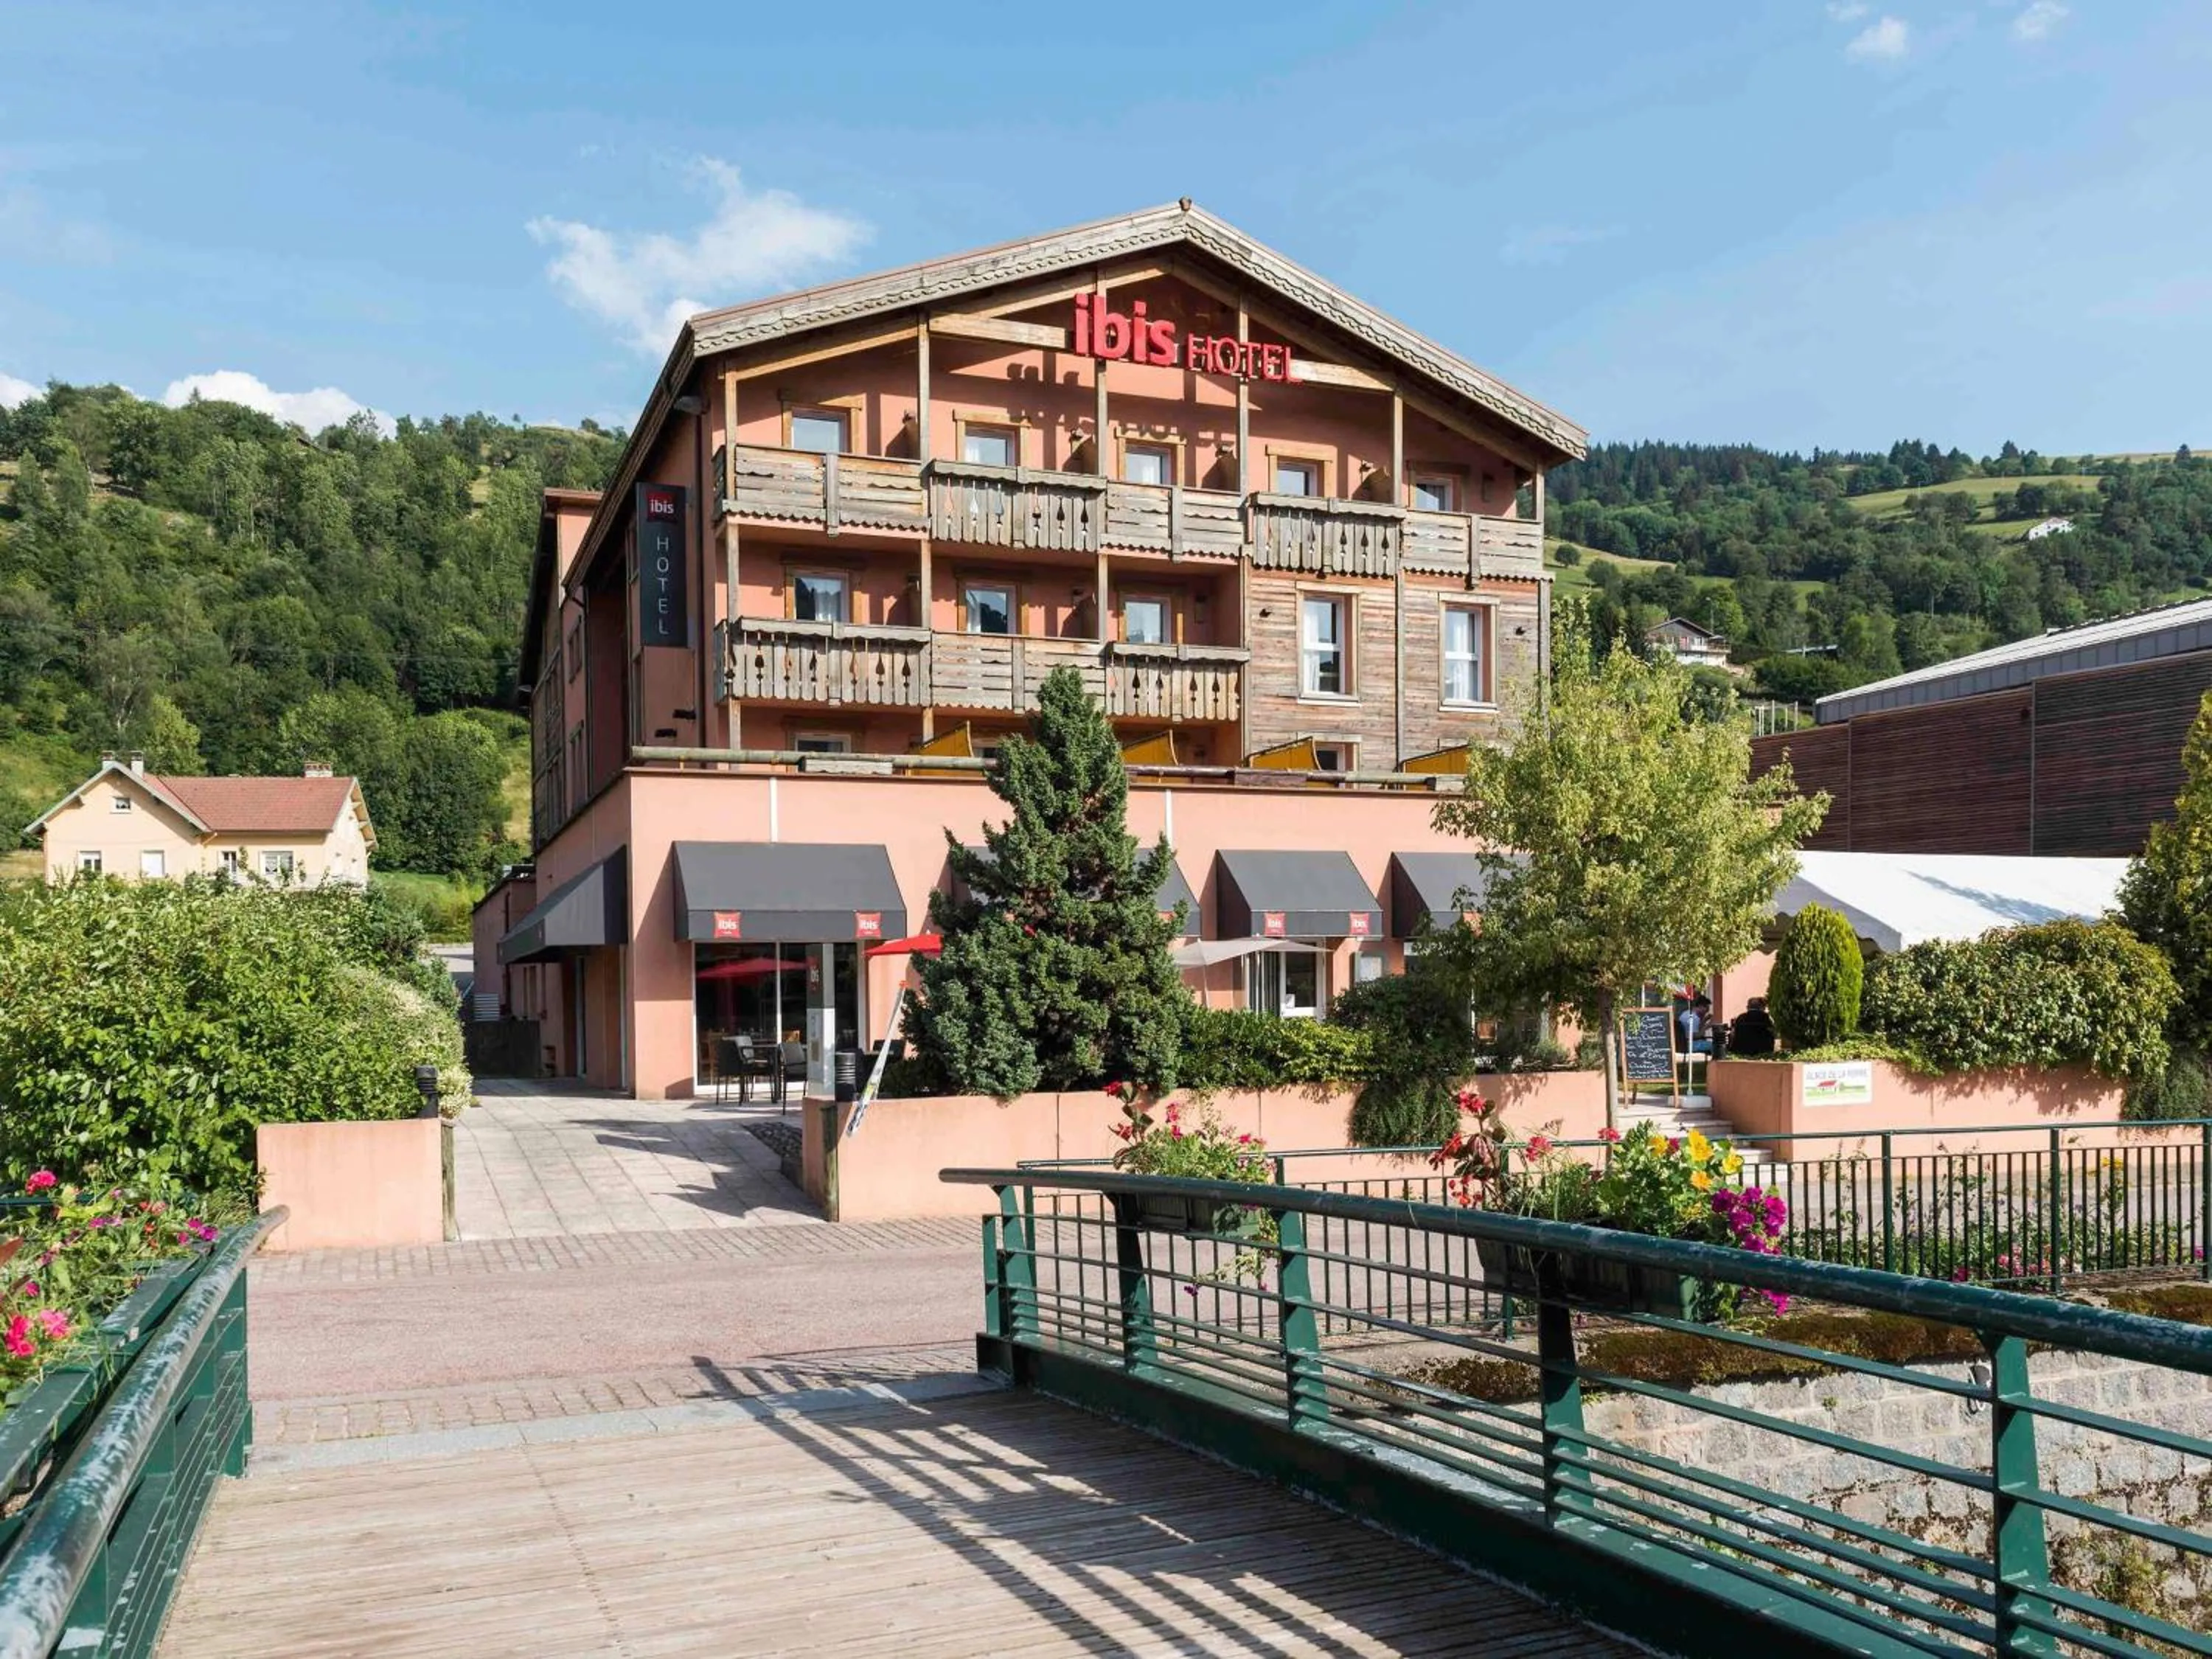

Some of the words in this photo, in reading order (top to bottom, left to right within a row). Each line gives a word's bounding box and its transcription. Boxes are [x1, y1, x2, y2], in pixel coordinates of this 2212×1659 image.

[1074, 293, 1177, 366] ibis
[1186, 330, 1304, 386] HOTEL
[650, 498, 675, 514] ibis
[656, 536, 669, 635] HOTEL
[717, 919, 737, 931] ibis
[859, 919, 878, 930] ibis
